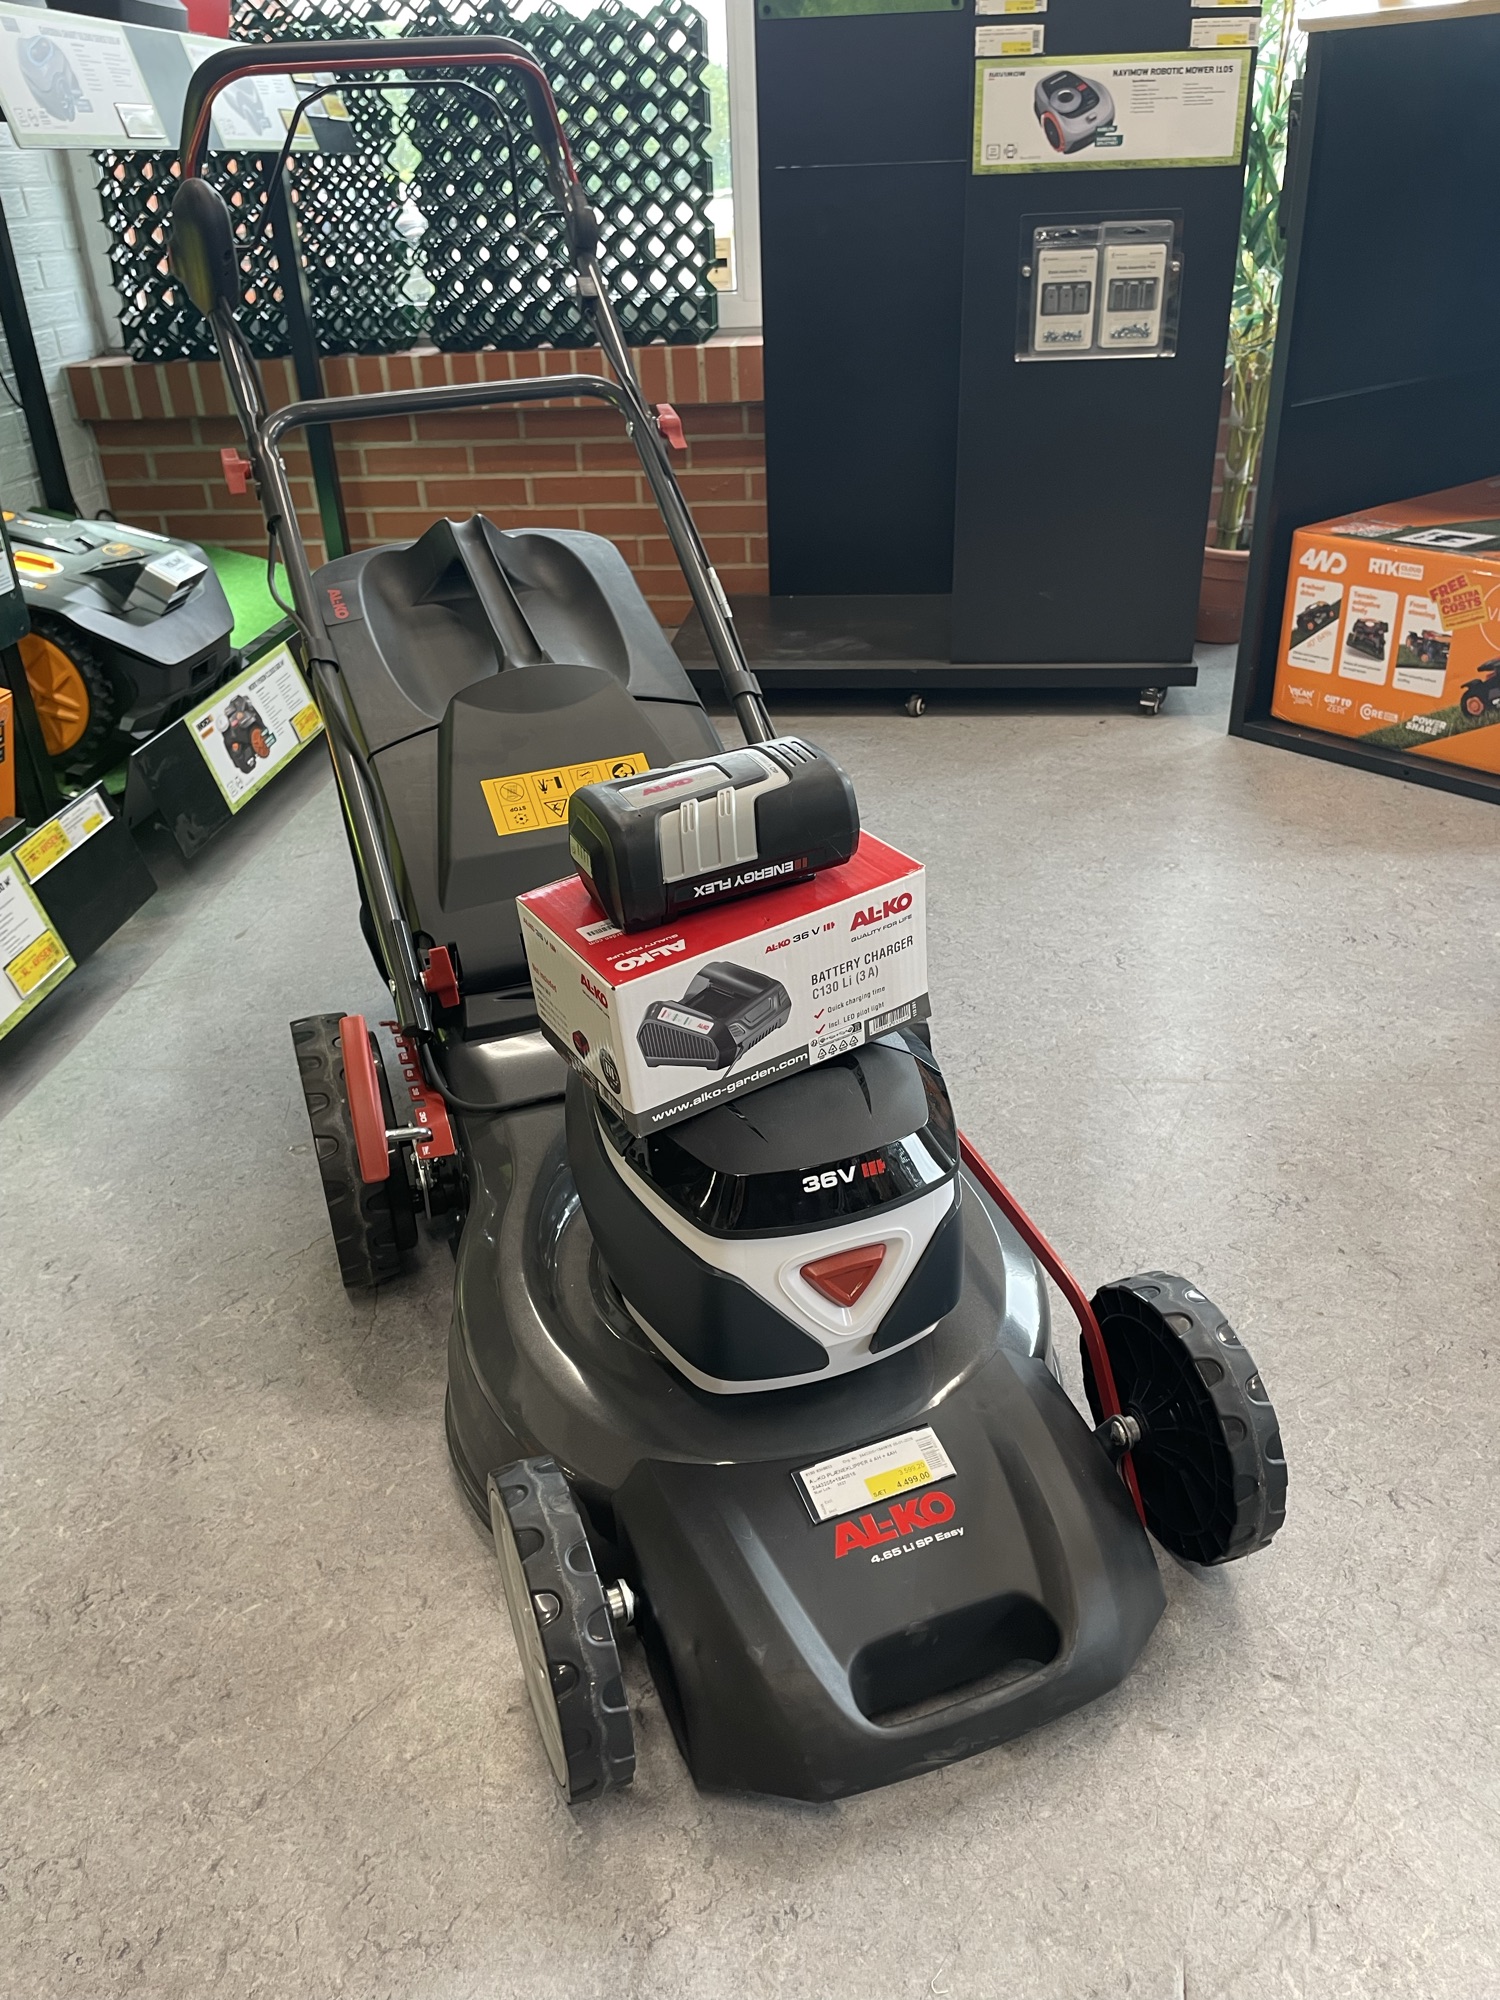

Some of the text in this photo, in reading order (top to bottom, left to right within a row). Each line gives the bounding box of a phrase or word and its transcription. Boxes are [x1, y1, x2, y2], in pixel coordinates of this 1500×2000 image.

[1112, 68, 1149, 76] NAVIMOW
[1150, 67, 1184, 76] ROBOTIC
[1185, 66, 1214, 74] MOWER
[1299, 548, 1347, 575] 4WD
[1368, 557, 1399, 577] RTK
[1429, 575, 1468, 603] FREE
[1440, 590, 1480, 605] NO EXTRA
[327, 589, 349, 620] AL-KO
[1441, 596, 1482, 615] COSTS
[1412, 715, 1447, 730] POWER
[643, 778, 694, 796] AL-KO
[694, 861, 794, 898] ENERGY FLEX
[850, 892, 912, 932] AL-KO
[765, 927, 820, 954] AL-KO 36 V
[851, 914, 912, 942] QUALITY FOR LIFE
[606, 934, 678, 961] QUALITY FOR LIFE
[614, 939, 686, 972] AL-KO
[812, 936, 914, 986] BATTERY CHARGER
[581, 974, 608, 1008] AL-KO
[812, 980, 839, 1000] C130
[842, 976, 852, 988] Li
[828, 986, 886, 1014] Quick charging time
[828, 1002, 884, 1028] Incl. LED pilot light
[652, 1052, 808, 1122] www.alko-garden.com
[419, 1112, 428, 1122] 30
[802, 1166, 856, 1194] 36V
[872, 1488, 887, 1498] SÆT
[896, 1472, 930, 1488] 4.499,00
[835, 1491, 956, 1559] AL-KO
[871, 1527, 964, 1563] 4.65 Li SP Easy
